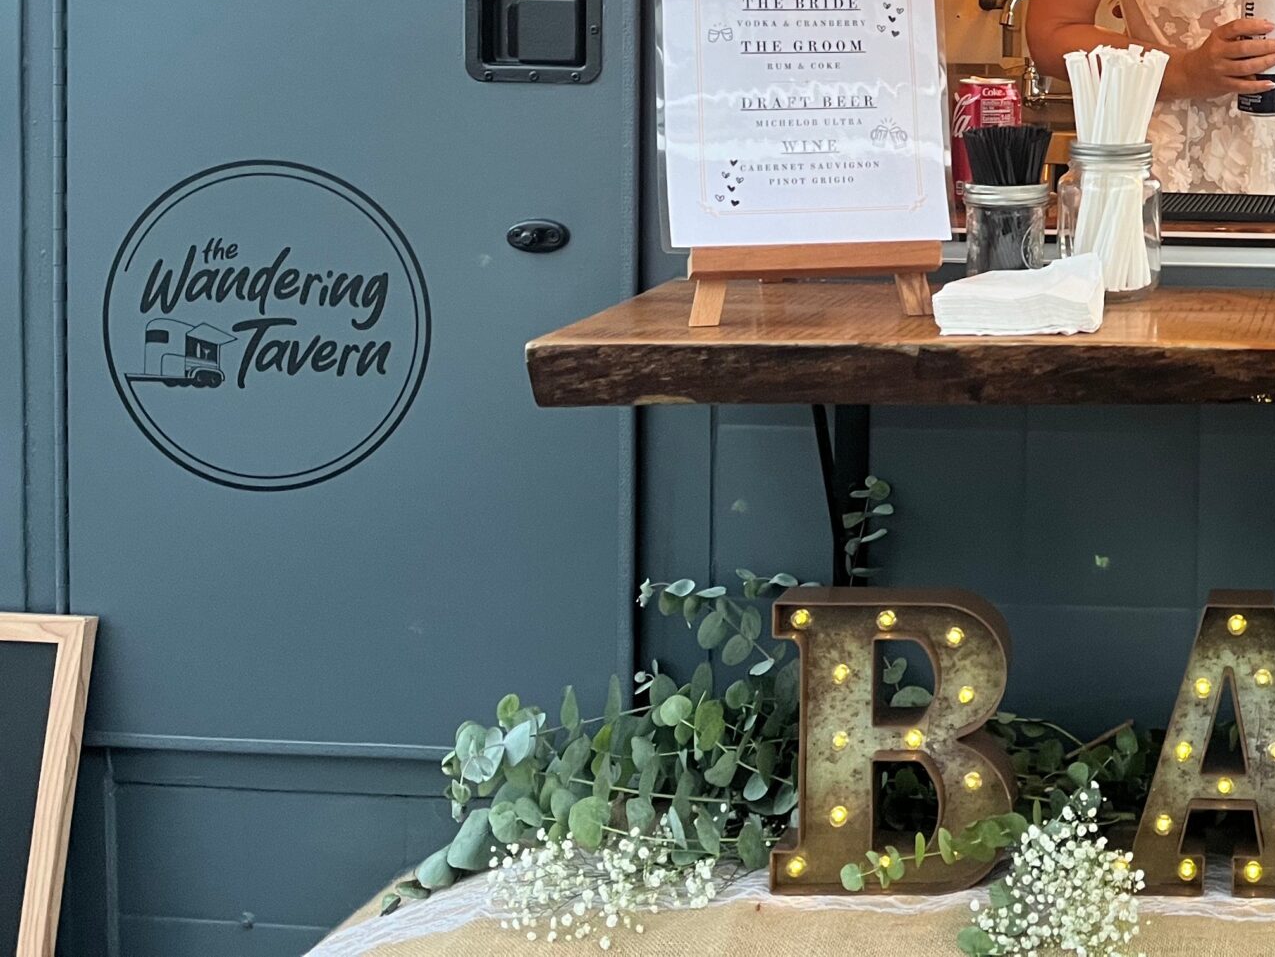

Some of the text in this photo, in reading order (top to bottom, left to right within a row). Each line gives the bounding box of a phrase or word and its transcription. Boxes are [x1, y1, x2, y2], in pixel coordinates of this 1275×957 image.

[737, 19, 867, 28] VODKA & CRANBERRY
[740, 39, 864, 53] THE GROOM
[767, 61, 842, 70] RUM & COKE
[982, 87, 1003, 97] Coke
[741, 94, 876, 110] DRAFT BEER
[756, 117, 864, 128] MICHELOB ULTRA
[782, 139, 838, 153] WINE
[740, 160, 881, 173] CABERNET SAUVIGNON
[769, 175, 855, 186] PINOT GRIGIO
[201, 237, 239, 265] the
[139, 243, 389, 332] Wandering
[231, 317, 393, 390] Tavern
